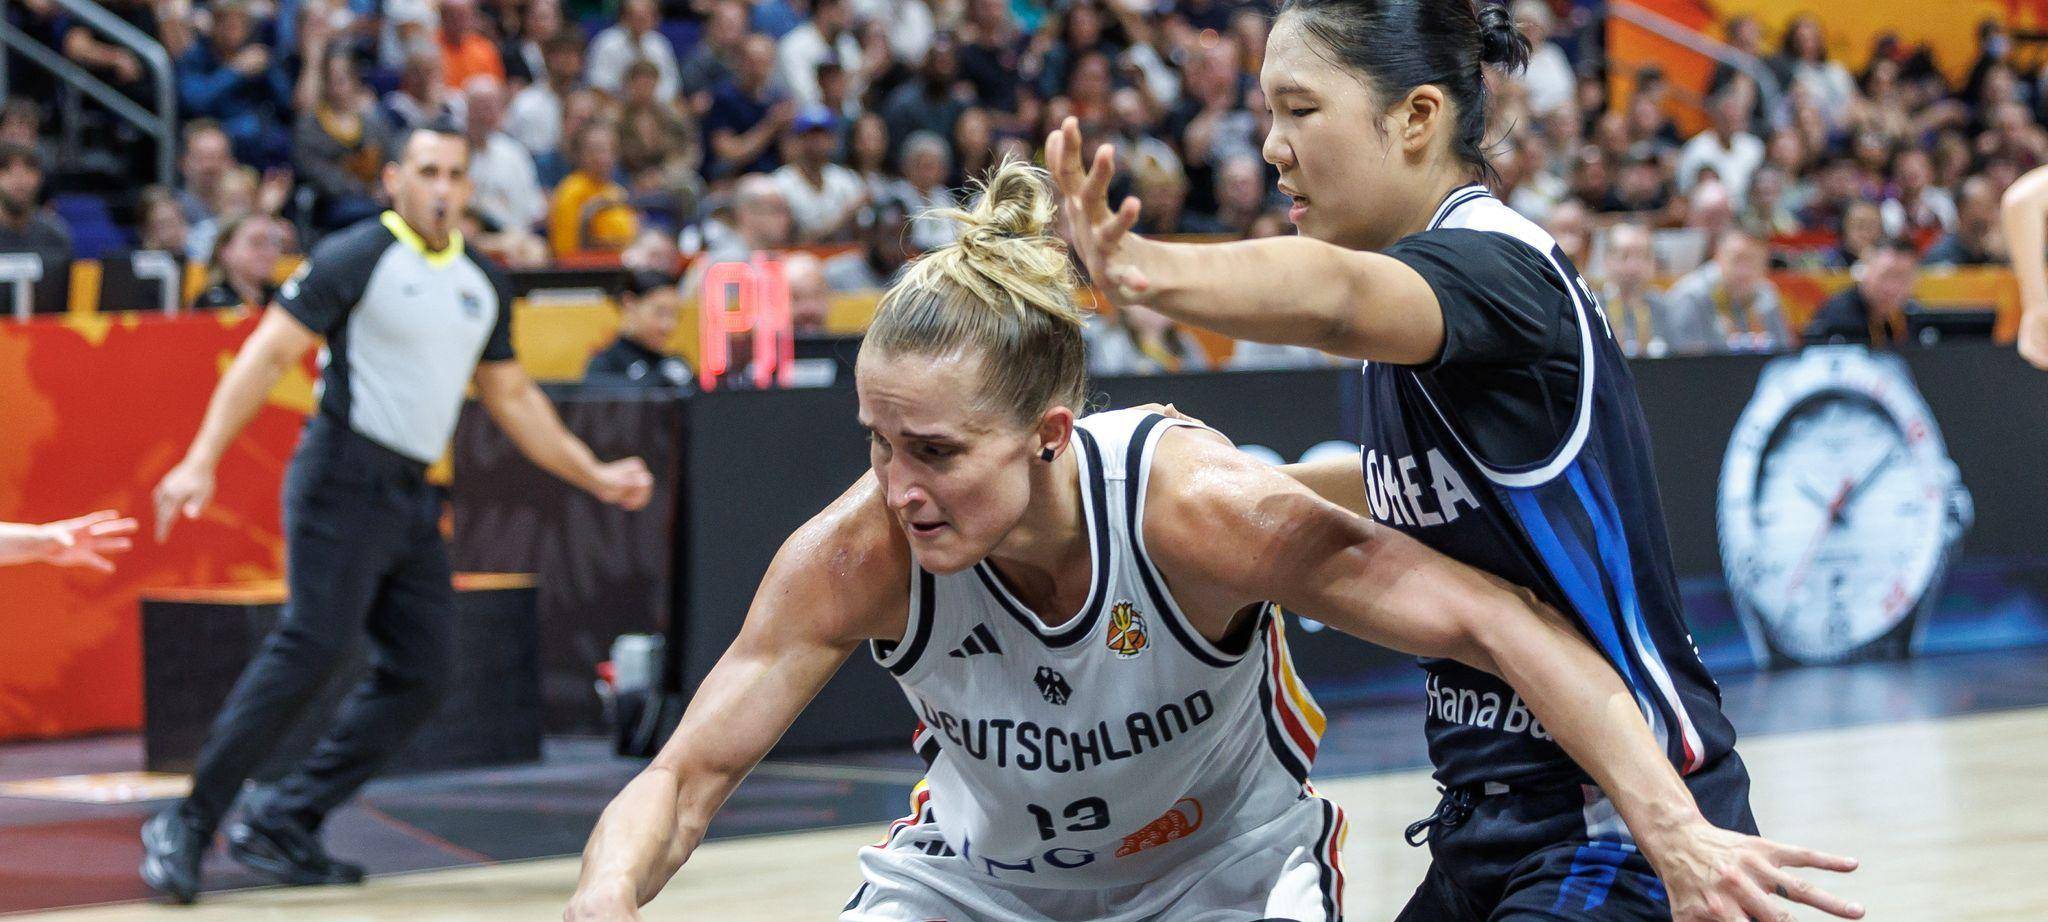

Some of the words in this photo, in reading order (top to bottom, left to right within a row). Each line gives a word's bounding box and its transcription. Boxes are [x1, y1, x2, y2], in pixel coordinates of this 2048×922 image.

[1360, 444, 1480, 527] OREA
[919, 689, 1214, 774] DEUTSCHLAND
[1425, 672, 1501, 730] Hana
[1503, 692, 1553, 742] Ba
[962, 829, 1099, 879] ING
[1026, 796, 1111, 842] 13
